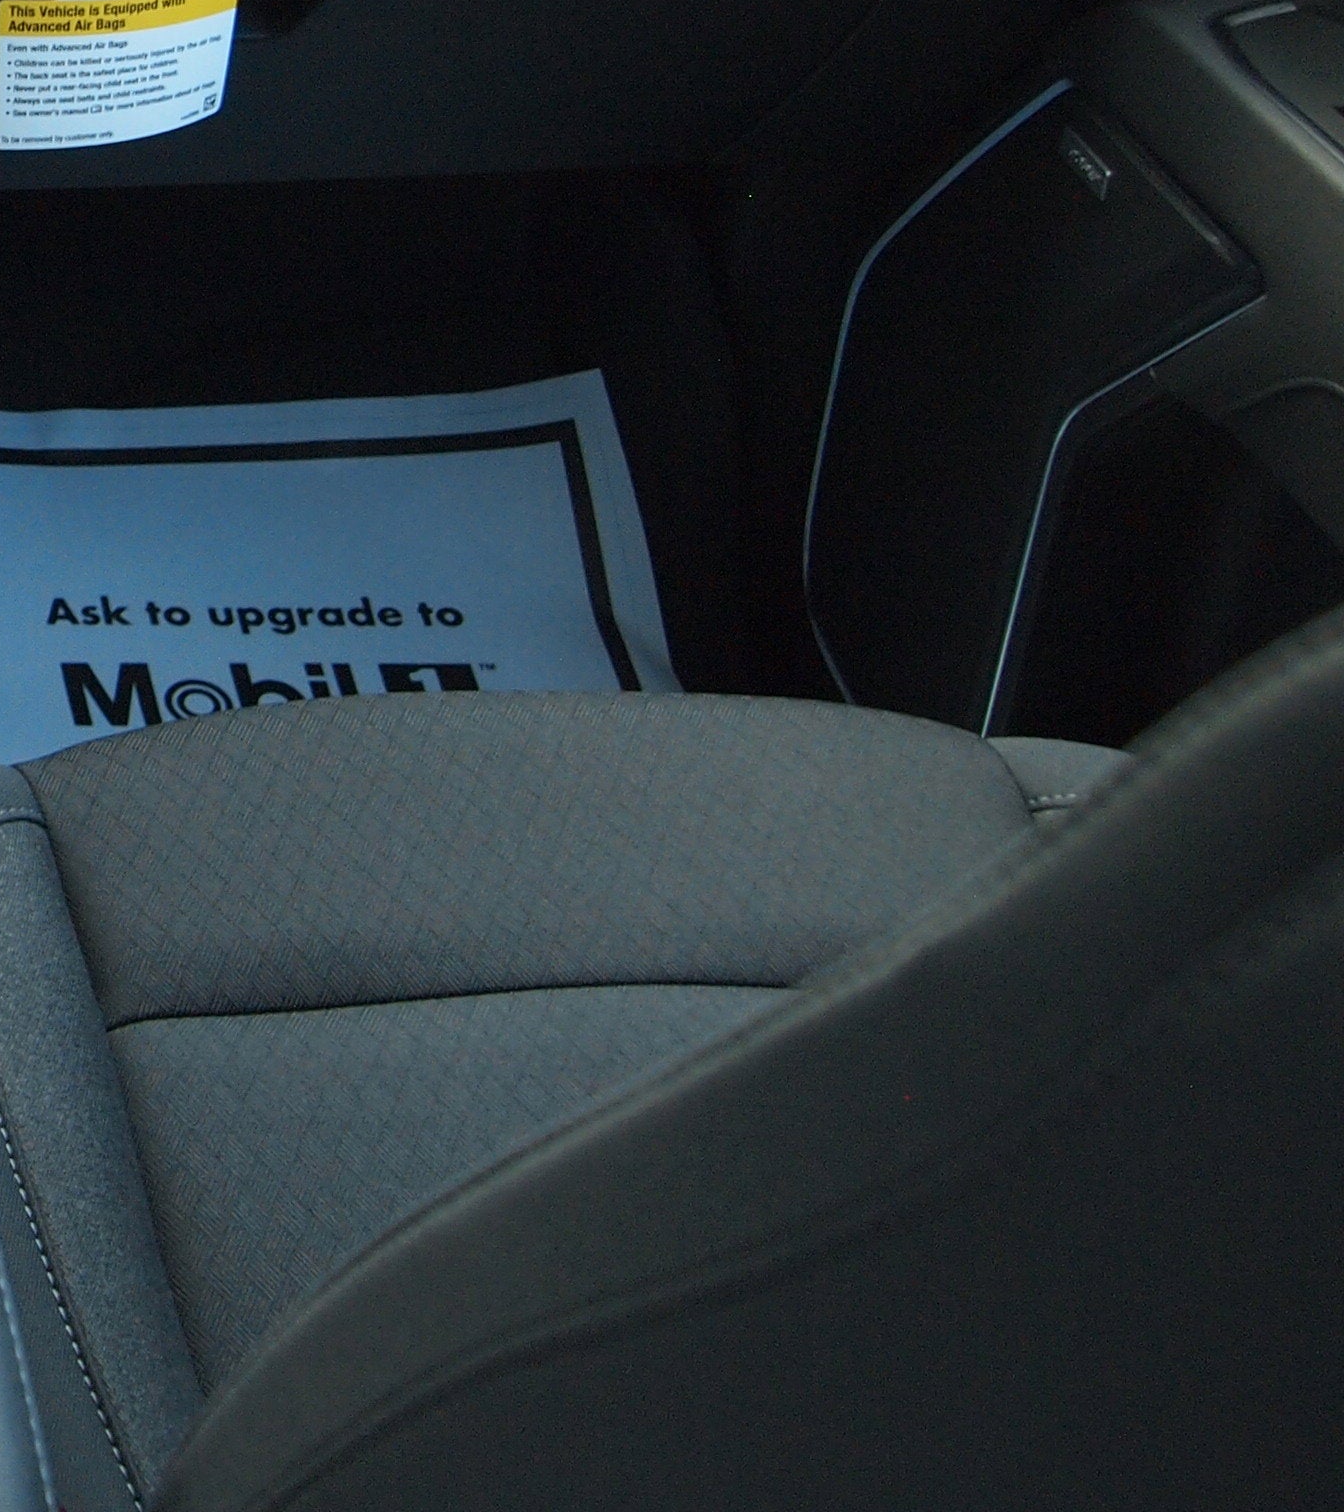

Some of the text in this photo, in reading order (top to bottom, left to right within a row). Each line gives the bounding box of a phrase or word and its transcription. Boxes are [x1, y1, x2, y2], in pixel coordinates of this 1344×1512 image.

[9, 5, 36, 18] This
[39, 5, 86, 18] Vehicle
[89, 4, 100, 16] is
[8, 18, 126, 32] Advanced Air Bags
[7, 44, 28, 53] Even
[30, 44, 49, 52] with
[51, 43, 92, 52] Advanced
[94, 42, 105, 50] Air
[46, 596, 464, 635] Ask to upgrade to
